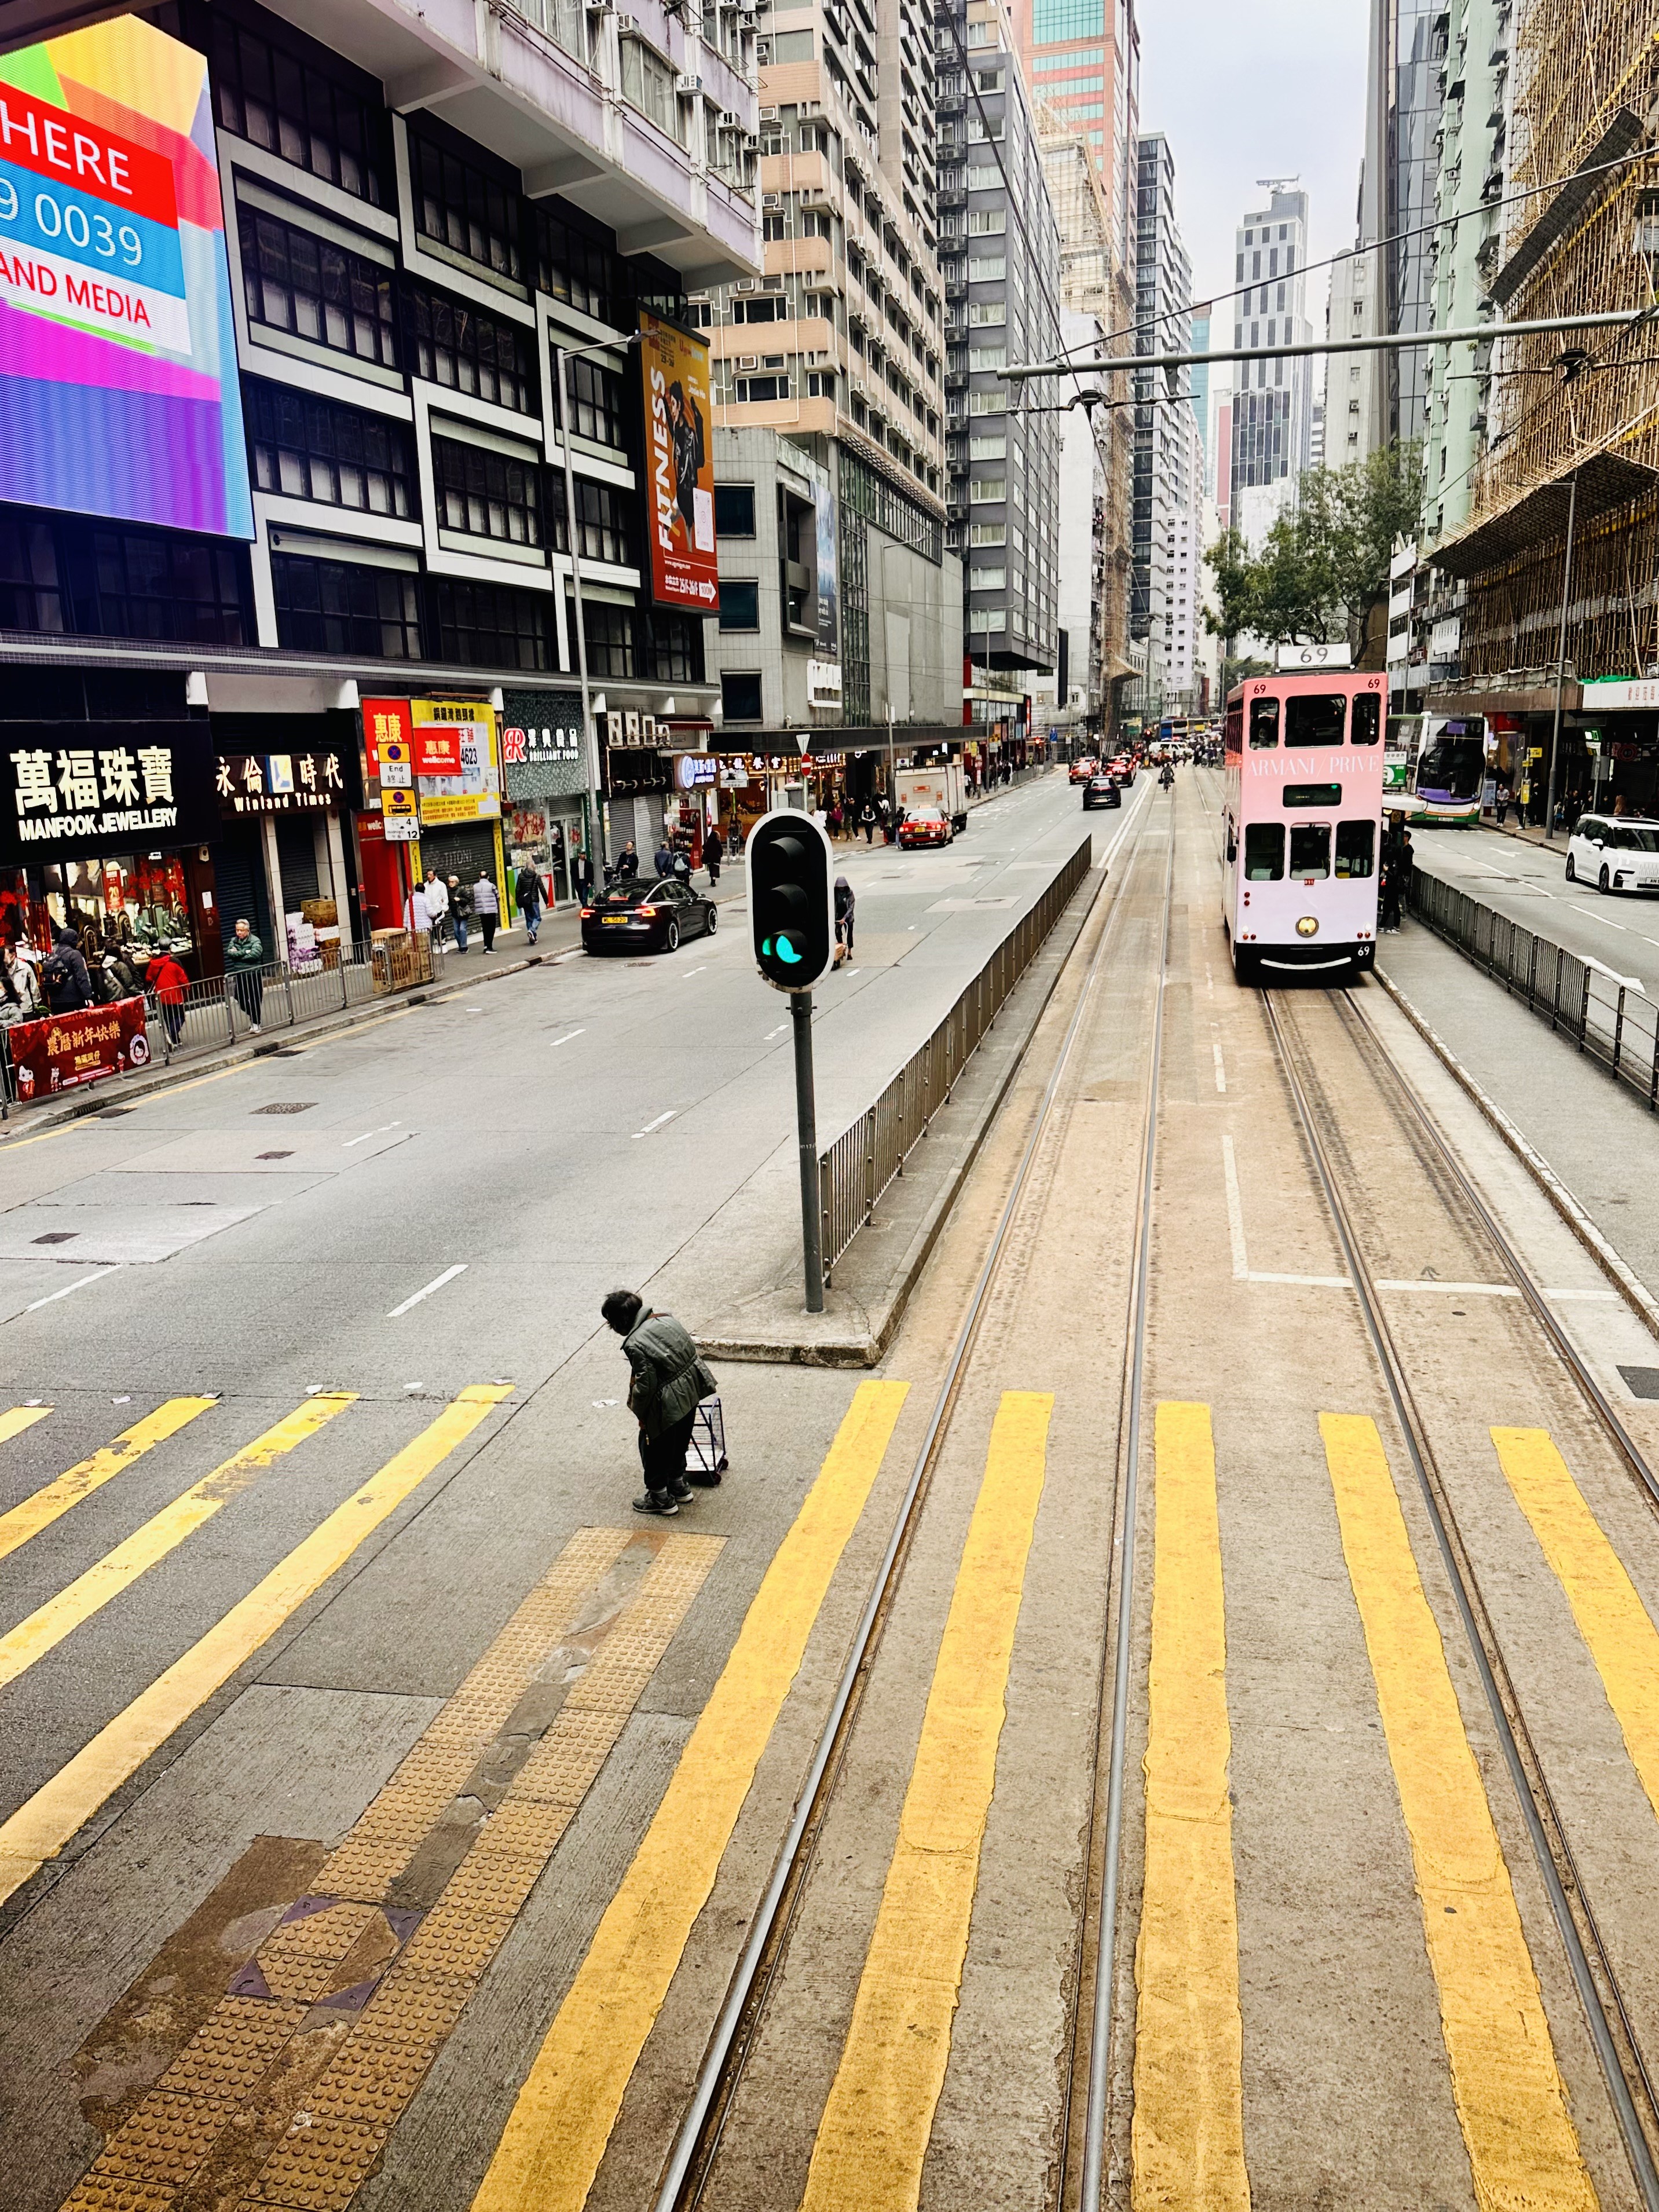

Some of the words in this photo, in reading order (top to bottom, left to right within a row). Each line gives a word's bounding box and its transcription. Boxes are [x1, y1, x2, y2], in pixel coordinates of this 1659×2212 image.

[0, 100, 133, 195] HERE
[35, 193, 142, 266] 0039
[65, 274, 151, 328] MEDIA
[650, 365, 673, 552] FITNESS
[1300, 647, 1328, 664] 69
[1253, 684, 1266, 694] 69
[1368, 678, 1380, 688] 69
[373, 713, 402, 743] 惠康
[424, 740, 451, 755] 惠康
[529, 750, 562, 762] BRILLIANT
[562, 749, 579, 760] FOOD
[422, 756, 456, 764] wellcome
[10, 746, 175, 815] 萬福珠寶
[387, 775, 405, 783] 終止
[234, 794, 289, 812] Winland
[295, 792, 331, 807] Times
[18, 814, 98, 841] MANFOOK
[97, 807, 178, 835] JEWELLERY
[407, 830, 418, 838] 12
[1357, 946, 1370, 957] 69
[47, 1020, 121, 1056] 農曆新年快樂
